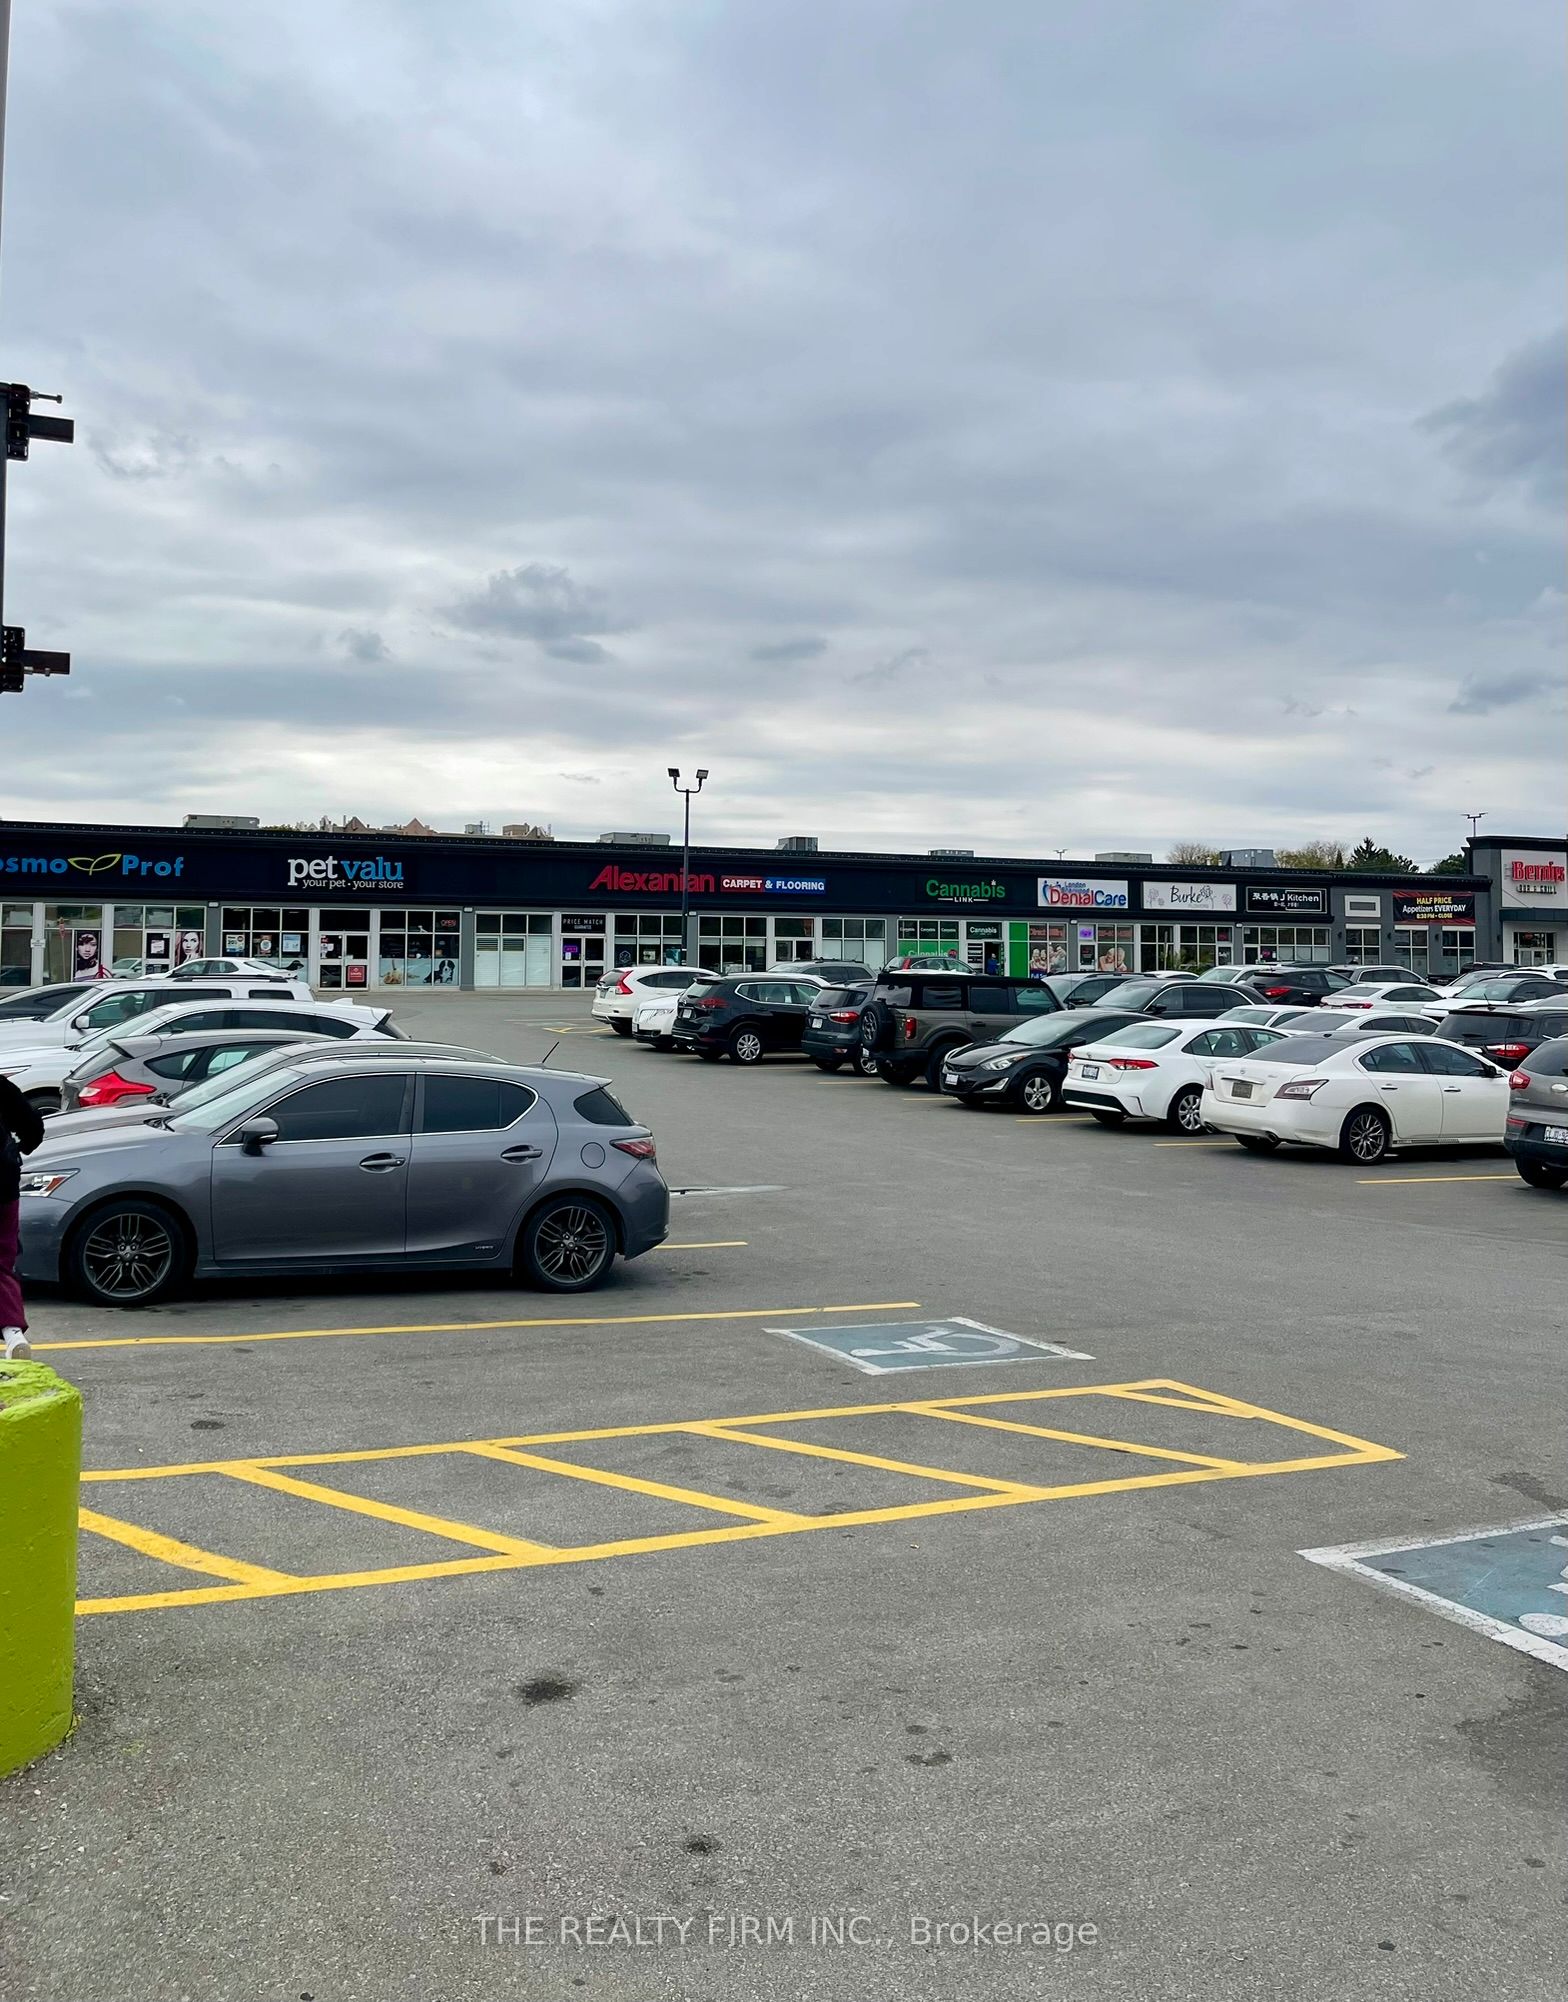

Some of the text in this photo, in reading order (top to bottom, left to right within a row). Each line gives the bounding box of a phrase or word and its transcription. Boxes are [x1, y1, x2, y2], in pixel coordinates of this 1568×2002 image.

[0, 857, 68, 874] smo
[122, 854, 184, 877] Prof
[287, 855, 404, 886] pet valu
[302, 879, 404, 890] your pet your store
[588, 865, 715, 893] Alexanian
[722, 878, 825, 891] CARPET & FLOORING
[926, 879, 1006, 898] Cannabis
[1050, 889, 1127, 906] DentalCare
[1287, 893, 1319, 902] Kitchen
[1402, 904, 1466, 914] Appetizers EVERYDAY
[969, 926, 998, 934] Cannabis
